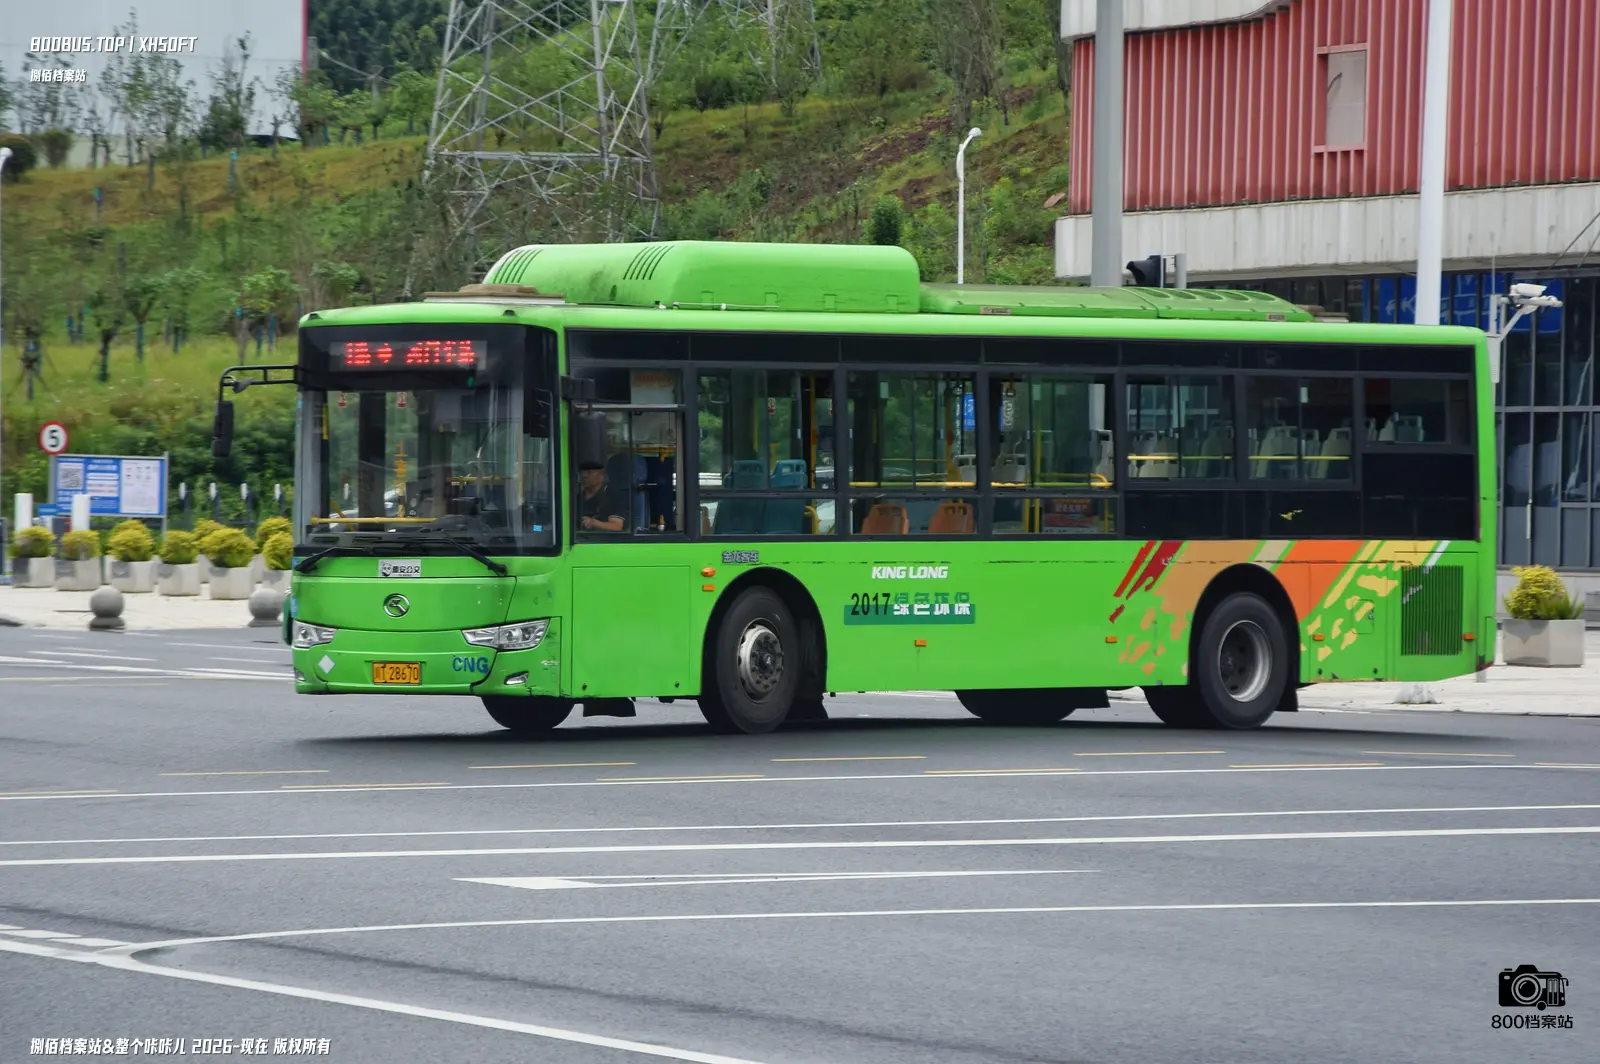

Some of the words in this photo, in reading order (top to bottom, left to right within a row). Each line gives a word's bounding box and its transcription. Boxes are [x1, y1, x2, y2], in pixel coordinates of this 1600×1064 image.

[49, 429, 59, 448] 5
[722, 550, 760, 564] 金龙客车
[871, 566, 907, 579] KING
[908, 566, 949, 579] LONG
[850, 592, 891, 616] 2017
[893, 592, 971, 616] 绿色环保
[452, 657, 489, 674] CNG
